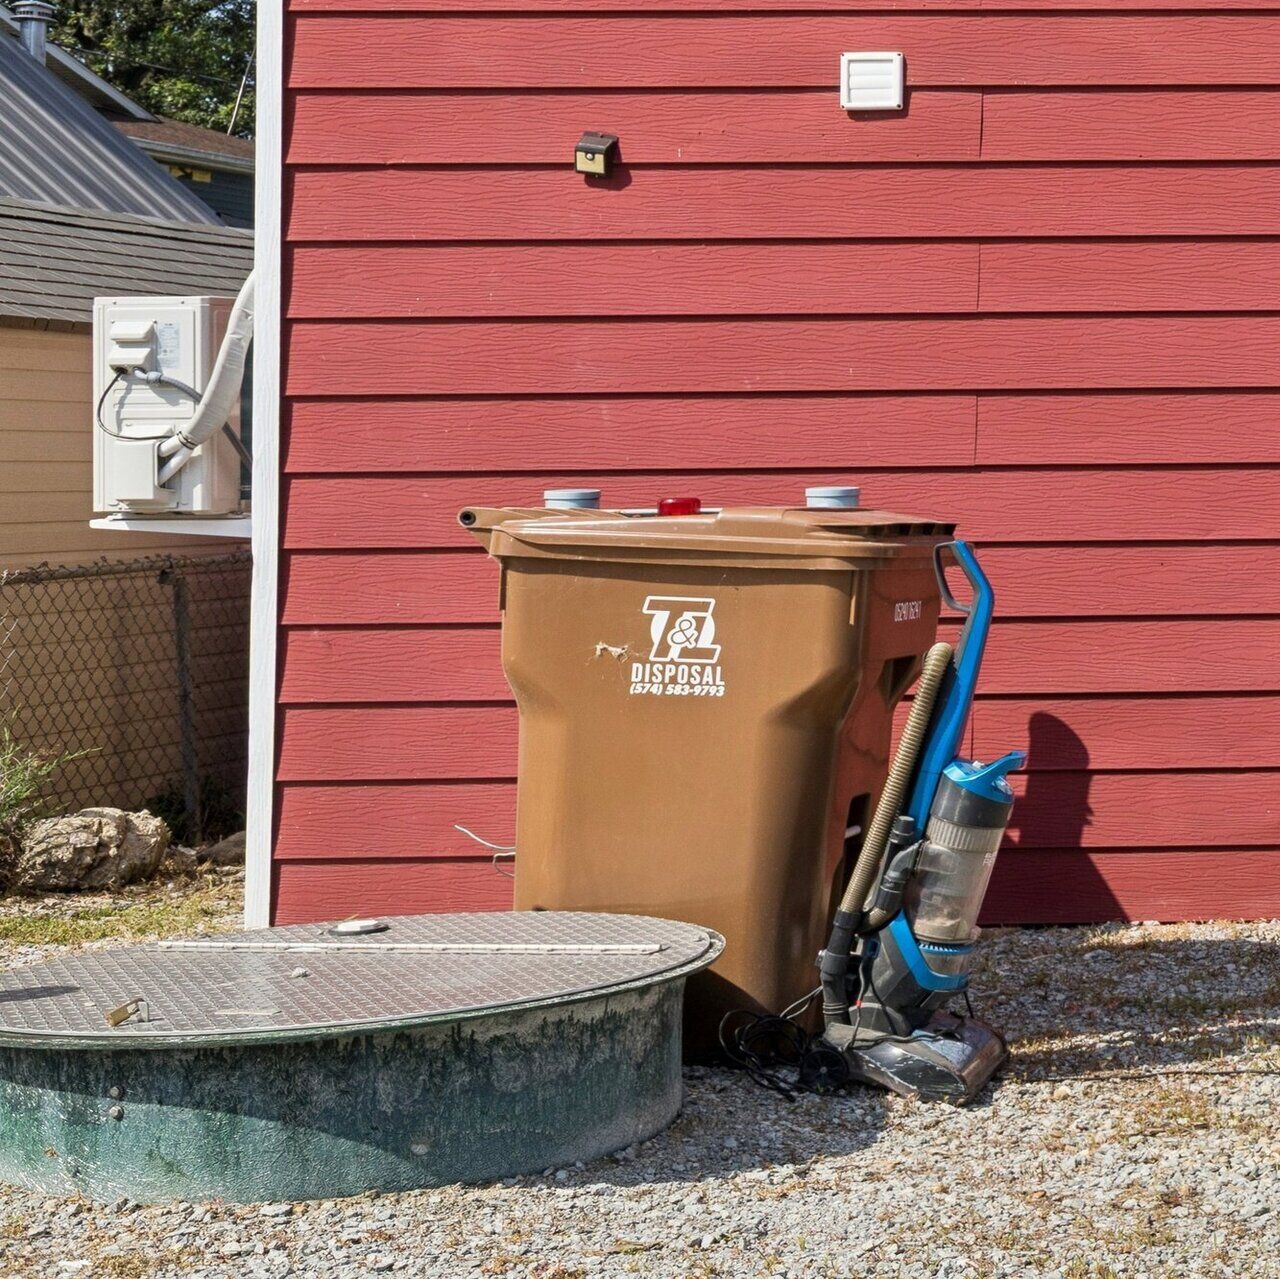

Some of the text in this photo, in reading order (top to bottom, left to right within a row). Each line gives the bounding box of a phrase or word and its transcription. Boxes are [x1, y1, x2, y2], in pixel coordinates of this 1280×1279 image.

[631, 663, 725, 685] DISPOSAL
[630, 682, 725, 697] (574) 583-9793
